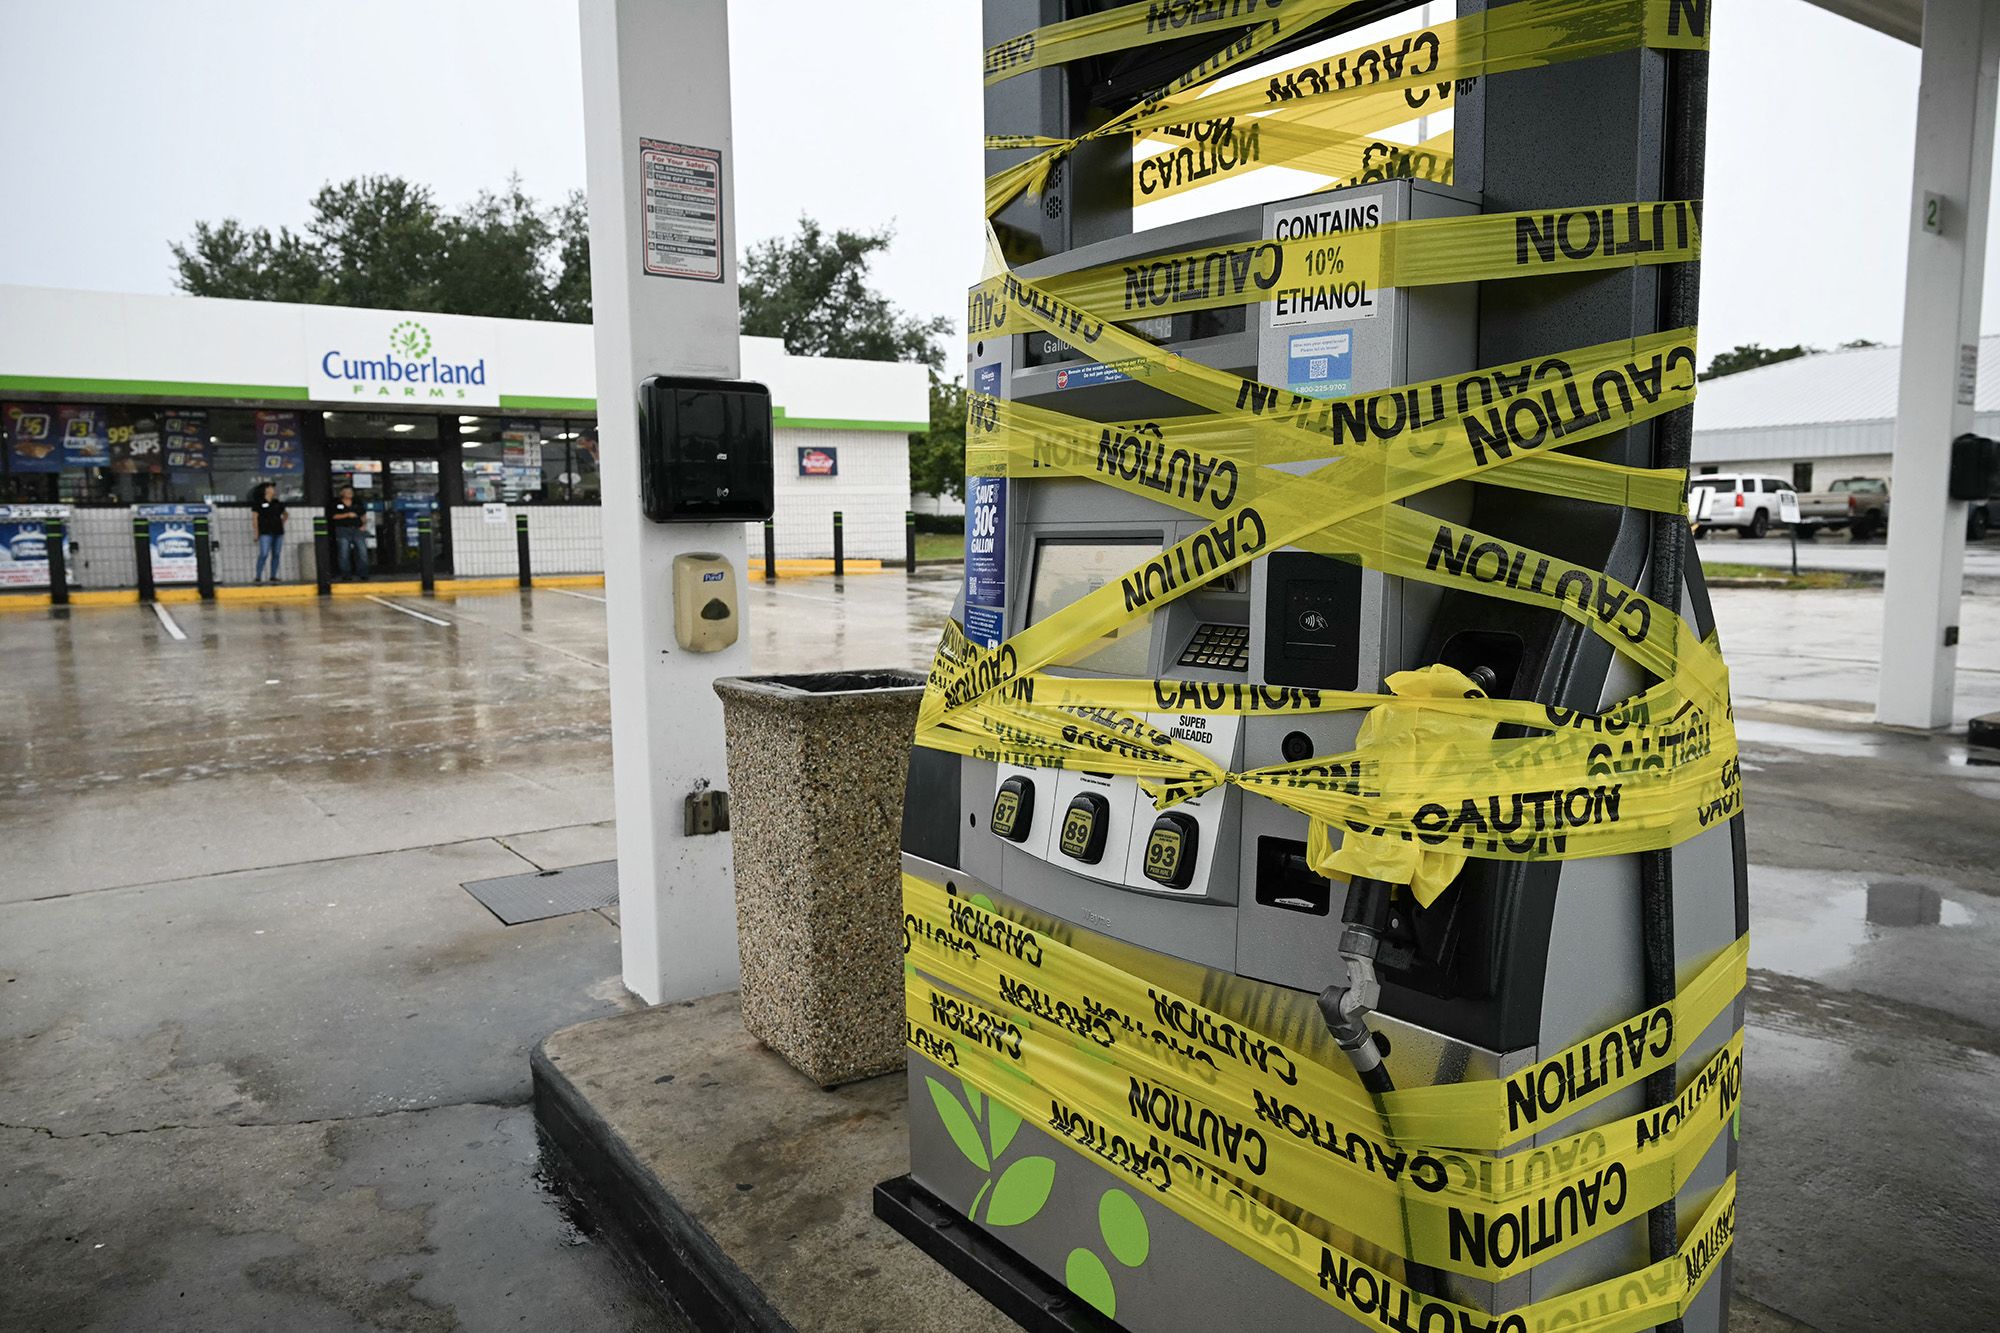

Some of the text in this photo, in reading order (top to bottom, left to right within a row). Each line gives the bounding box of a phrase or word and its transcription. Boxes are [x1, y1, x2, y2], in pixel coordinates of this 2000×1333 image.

[667, 157, 684, 166] Your
[1276, 204, 1379, 243] CONTAINS
[1926, 199, 1938, 227] 2
[1124, 243, 1284, 310] CAUTION
[1304, 246, 1344, 277] 10%
[1276, 280, 1373, 317] ETHANOL
[322, 350, 485, 385] Cumberland
[352, 384, 466, 399] FARMS
[1332, 358, 1574, 446] CAUTION
[1463, 346, 1697, 467] CAUTION
[129, 438, 161, 456] SIPS
[1097, 428, 1238, 511] CAUTION
[975, 484, 994, 504] SAVE
[972, 504, 997, 537] 30¢
[971, 538, 994, 554] GALLON
[1121, 507, 1267, 613] CAUTION
[1426, 525, 1652, 644] CAUTION
[1154, 680, 1321, 710] CAUTION
[1170, 727, 1213, 744] UNLEADED
[1179, 715, 1206, 729] SUPER
[996, 803, 1015, 822] 87
[1411, 784, 1622, 834] CAUTION
[1065, 821, 1088, 843] 89
[1150, 844, 1176, 867] 93
[948, 899, 1043, 968] CAUTION
[930, 992, 1022, 1060] CAUTION
[999, 974, 1115, 1047] CAUTION
[1149, 988, 1298, 1086] CAUTION
[1507, 1008, 1673, 1132] CAUTION
[1129, 1076, 1267, 1176] CAUTION
[1253, 1088, 1449, 1193] CAUTION
[1049, 1100, 1172, 1192] CAUTION
[1449, 1161, 1627, 1268] CAUTION
